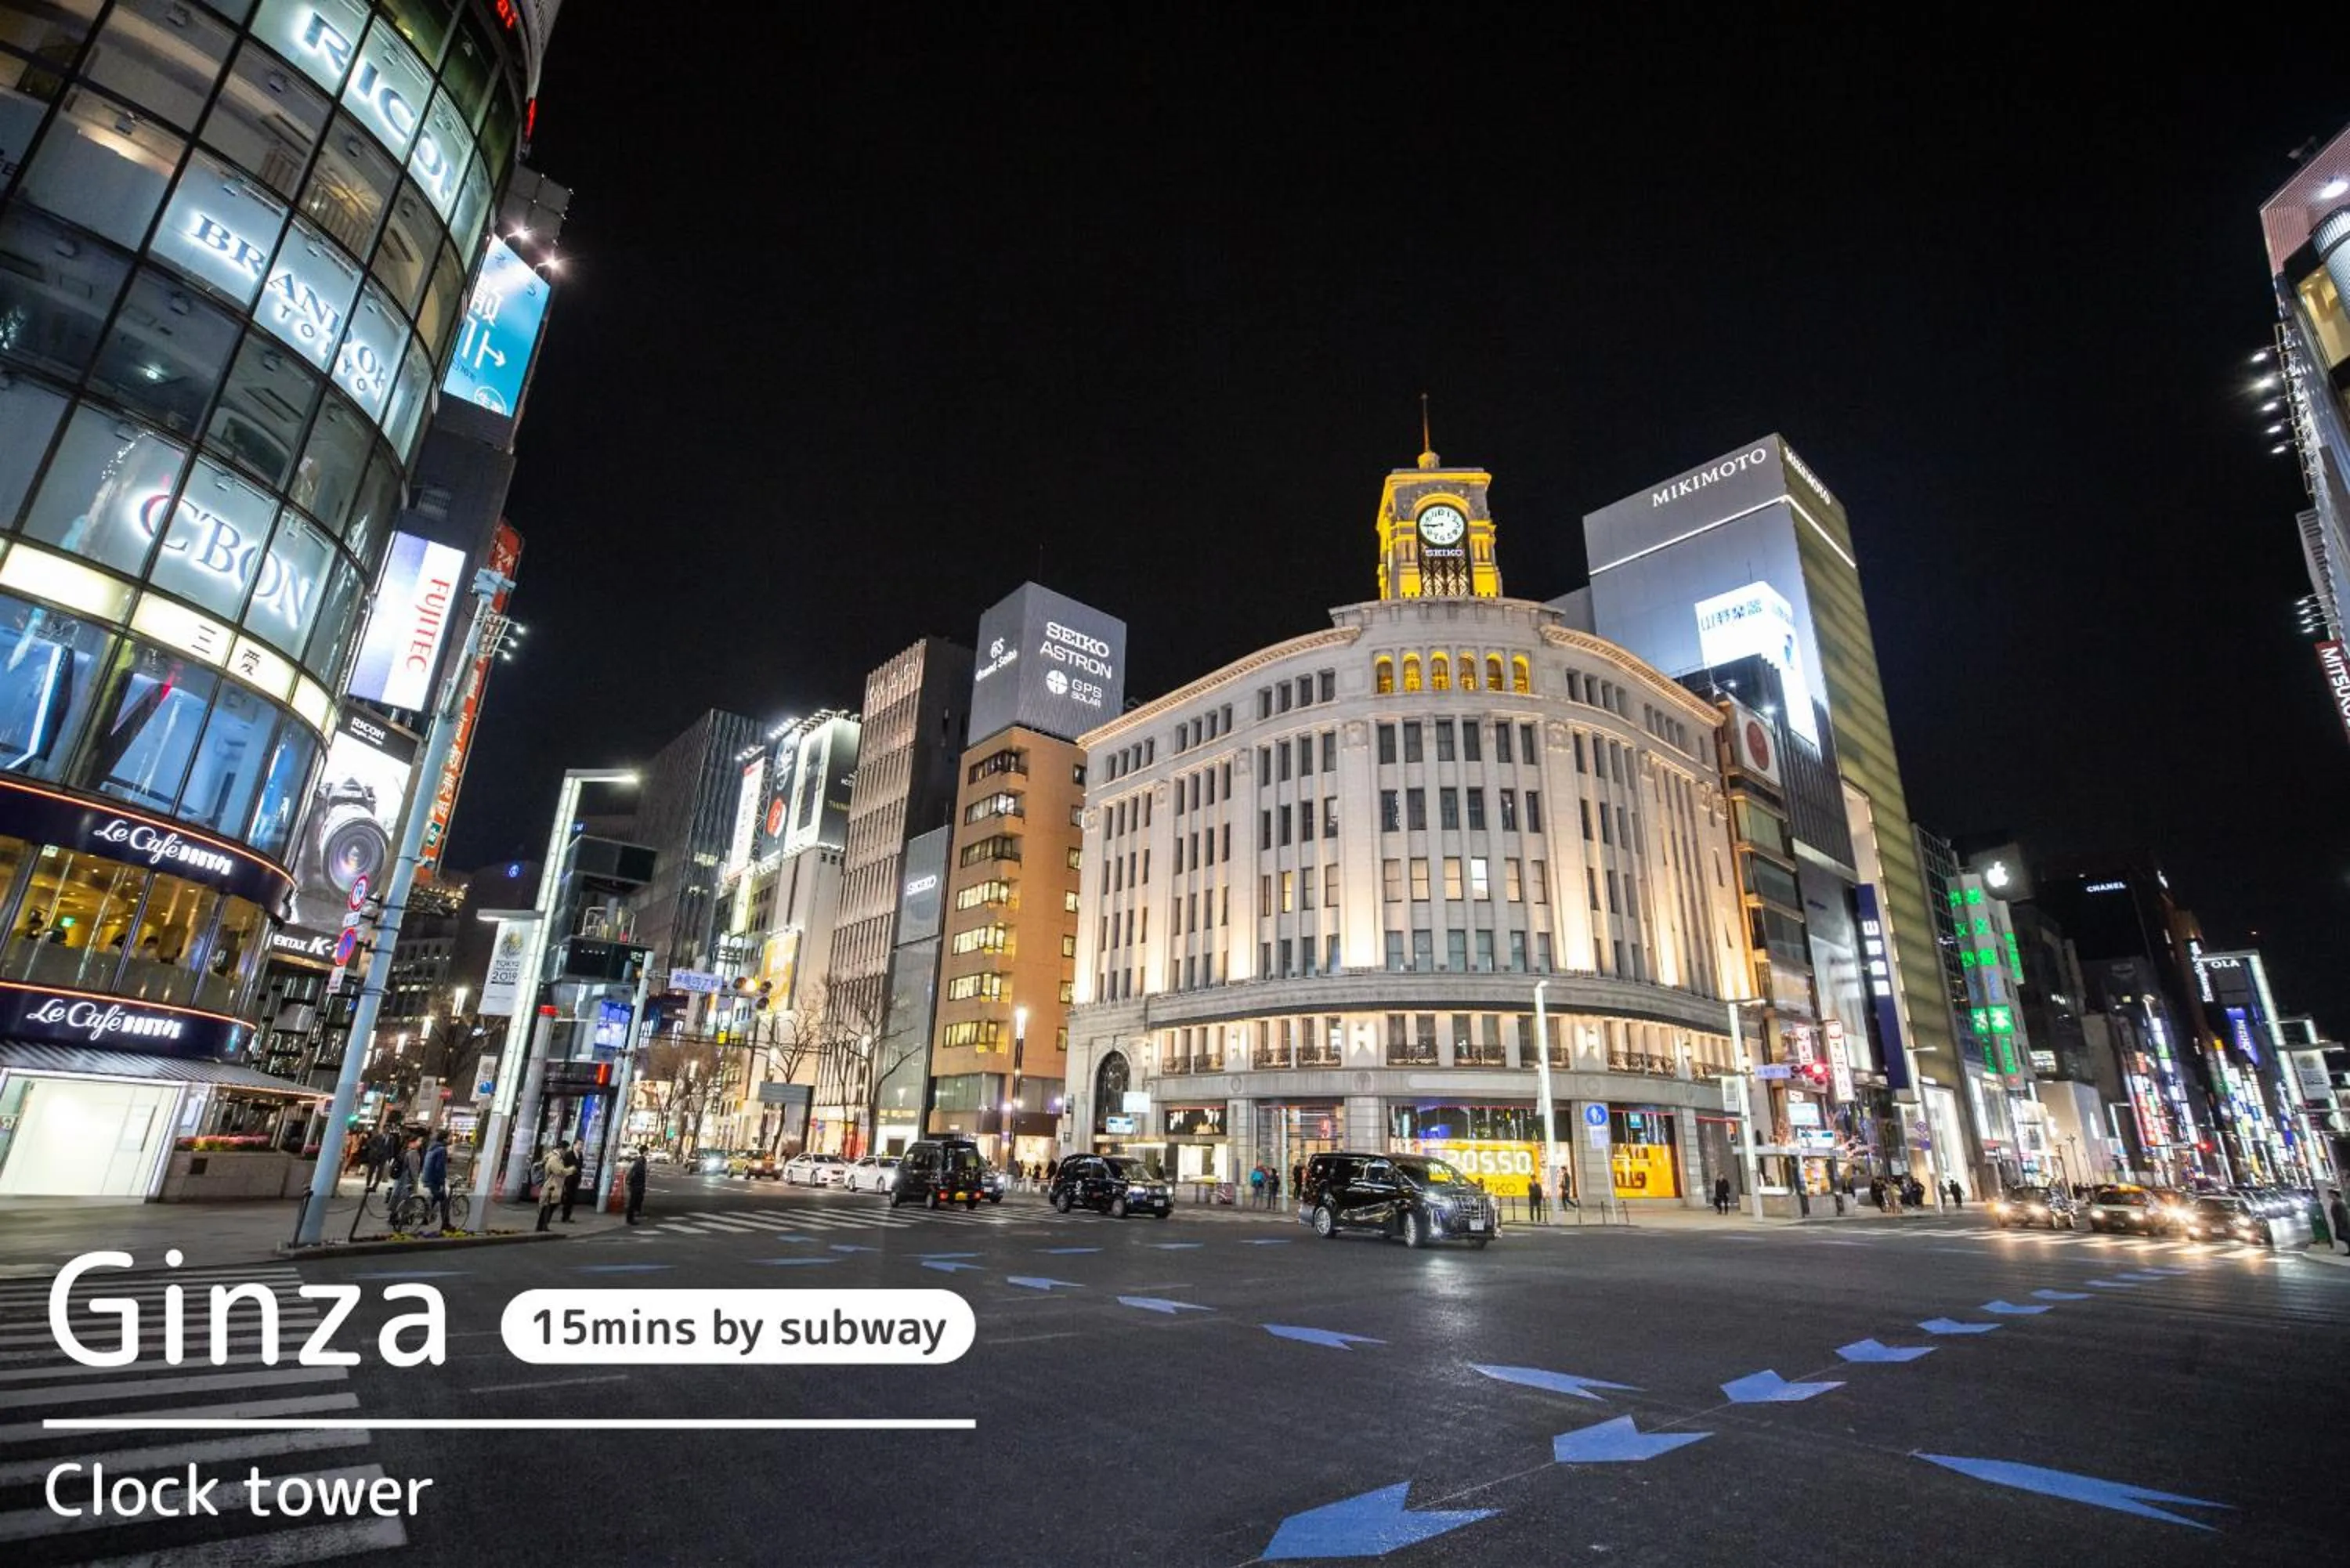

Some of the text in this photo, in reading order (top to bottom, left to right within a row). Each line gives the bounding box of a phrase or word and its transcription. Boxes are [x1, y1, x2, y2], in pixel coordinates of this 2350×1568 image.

[194, 214, 352, 344] BRAND
[1652, 448, 1766, 508] MIKIMOTO
[407, 578, 450, 674] FUJITEC
[1046, 621, 1109, 657] SEIKO
[1040, 641, 1112, 679] ASTRON
[1071, 691, 1101, 709] SOLAR
[1072, 679, 1102, 698] GPS
[351, 717, 386, 740] RICOH
[93, 819, 128, 842] Le
[130, 826, 179, 865] Café
[2086, 882, 2127, 893] CHANEL
[27, 999, 65, 1023] Le
[67, 1002, 121, 1040] Café
